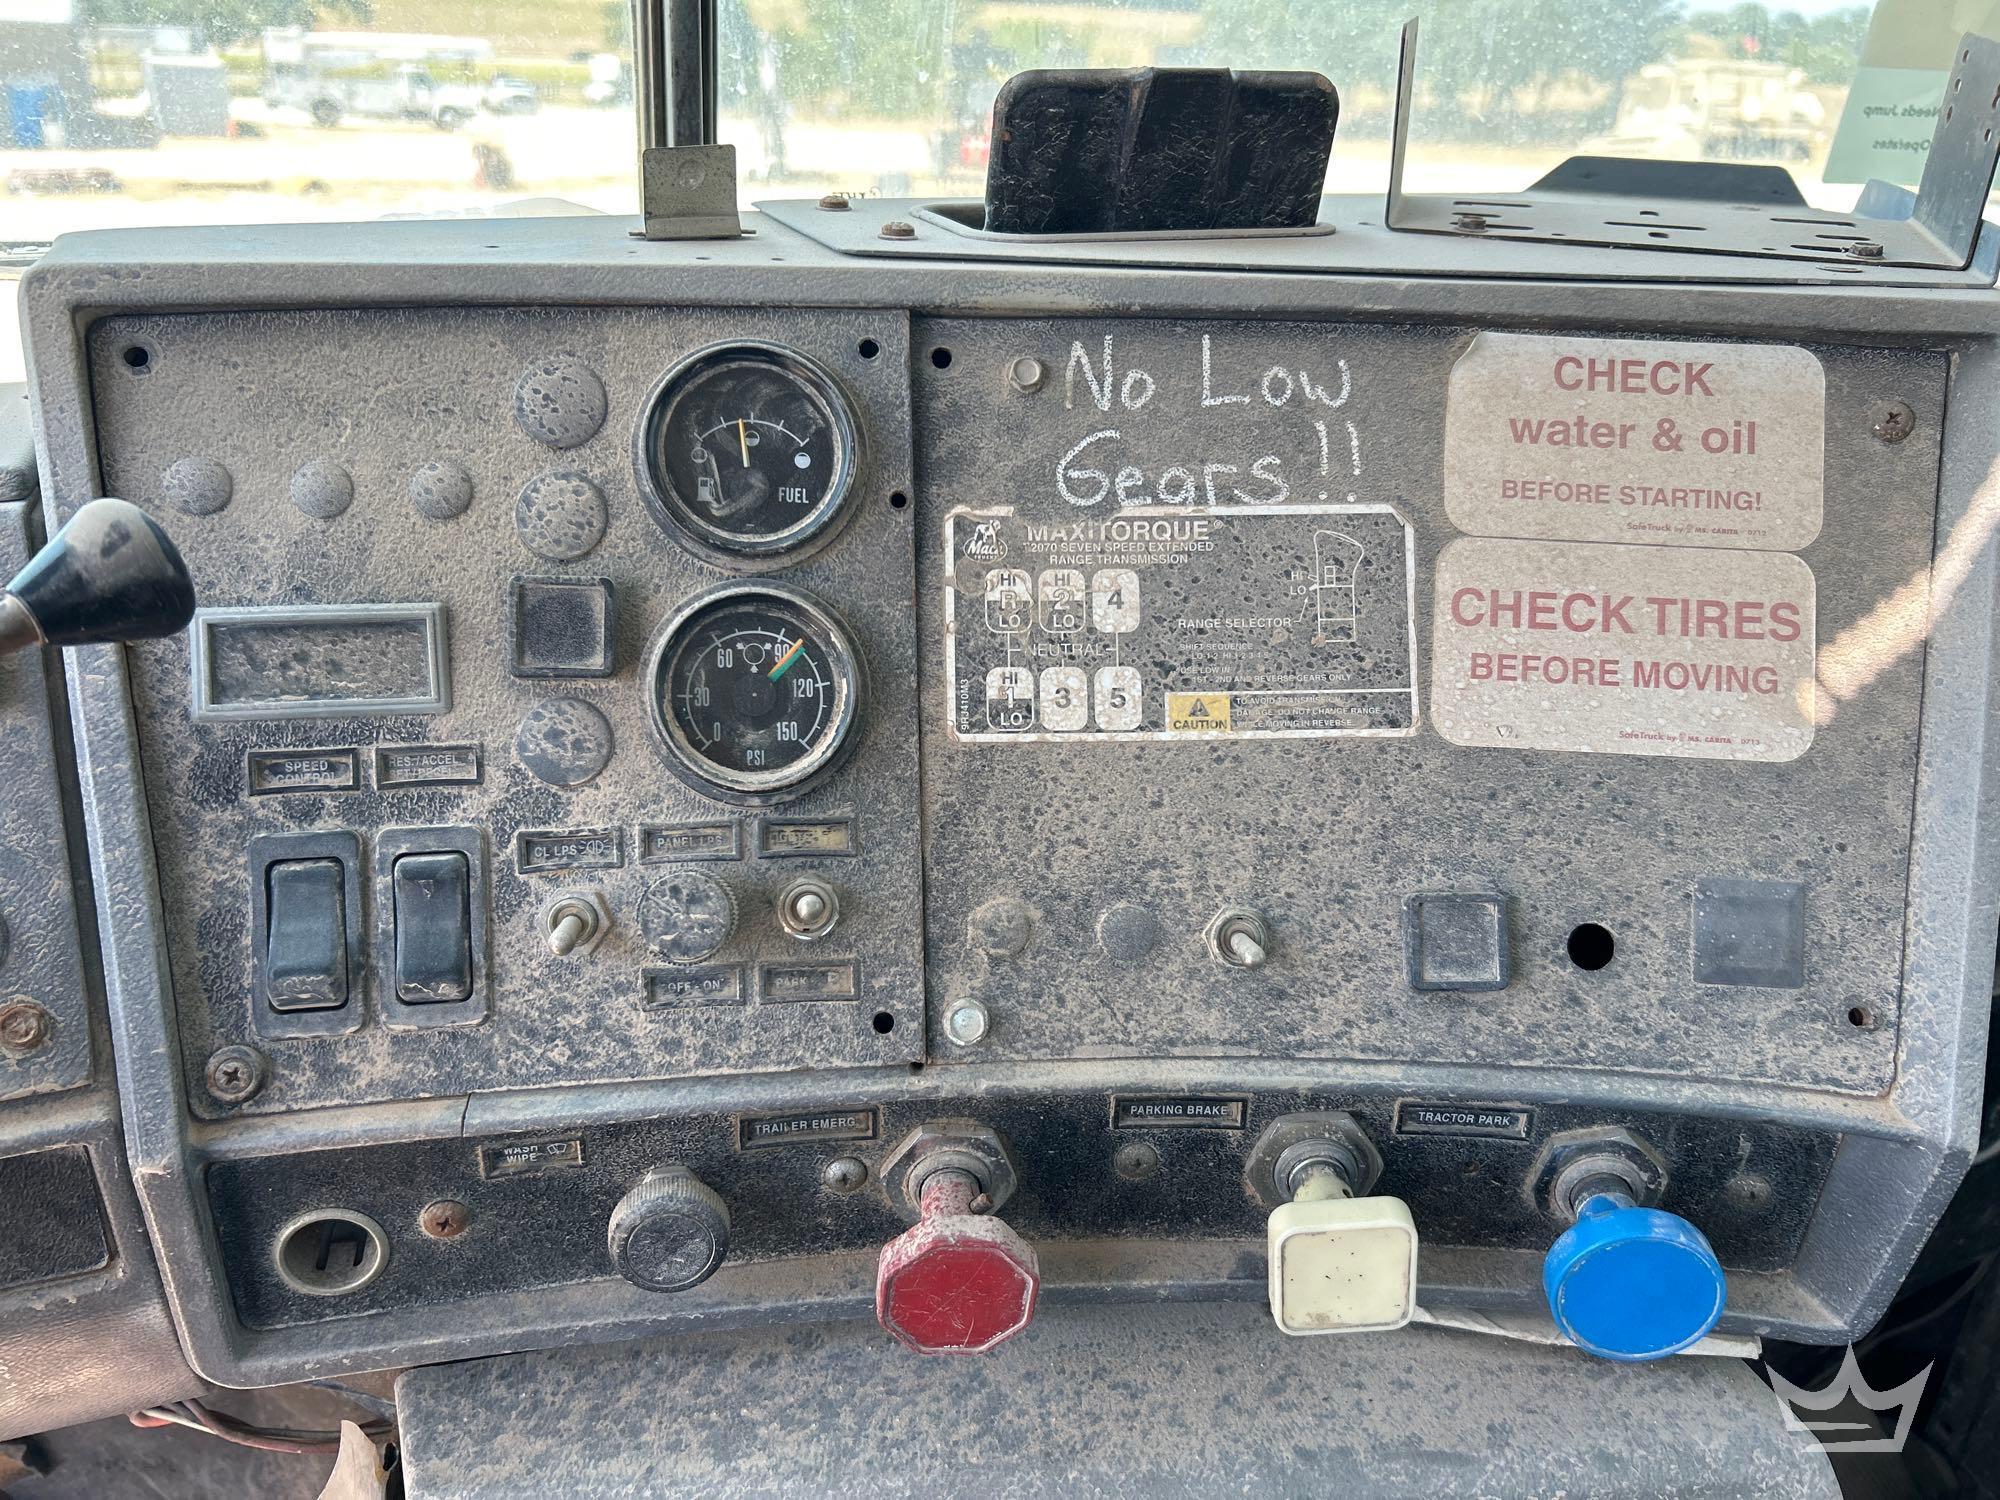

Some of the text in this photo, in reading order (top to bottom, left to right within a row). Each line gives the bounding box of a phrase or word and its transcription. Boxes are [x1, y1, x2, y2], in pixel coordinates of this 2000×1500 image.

[1065, 334, 1351, 411] No Low
[1553, 356, 1714, 397] CHECK
[1509, 415, 1756, 455] water & oil
[779, 487, 810, 504] FUEL
[1501, 480, 1762, 512] BEFORE STARTING!
[1061, 542, 1100, 552] SEVEN
[1105, 542, 1141, 552] SPEED
[1149, 542, 1214, 552] EXTENDED
[1050, 554, 1188, 565] RANGE TRANSMISSION
[1000, 573, 1016, 586] HI
[1055, 573, 1070, 586] HI
[1290, 586, 1306, 595] LO
[1001, 591, 1016, 609] R
[1053, 591, 1070, 610] 2
[1107, 591, 1124, 609] 4
[1000, 615, 1021, 628] LO
[1053, 615, 1075, 628] LO
[1451, 587, 1801, 642] CHECK TIRES
[1178, 618, 1292, 628] RANGE SELECTOR
[1027, 643, 1103, 656] NEUTRAL
[717, 649, 733, 668] 60
[1002, 672, 1017, 685] HI
[1471, 652, 1779, 695] BEFORE MOVING
[793, 678, 813, 697] 120
[694, 687, 710, 707] 30
[1004, 687, 1015, 708] 1
[1055, 687, 1071, 708] 3
[1110, 687, 1126, 708] 5
[1351, 707, 1381, 715] RANGE
[1000, 713, 1022, 726] LO
[1173, 720, 1228, 730] CAUTION
[714, 722, 721, 741] 0
[776, 722, 797, 741] 150
[747, 751, 765, 766] PSI
[285, 760, 328, 772] SPEED
[657, 836, 723, 849] PANEL LPS
[534, 844, 578, 858] CL LPS
[667, 982, 691, 992] OFF
[703, 980, 720, 990] ON
[1131, 1105, 1228, 1115] PARKING BRAKE
[1419, 1111, 1510, 1125] TRACTOR PARK
[755, 1121, 807, 1135] TRAILER
[507, 1153, 537, 1162] WIPE
